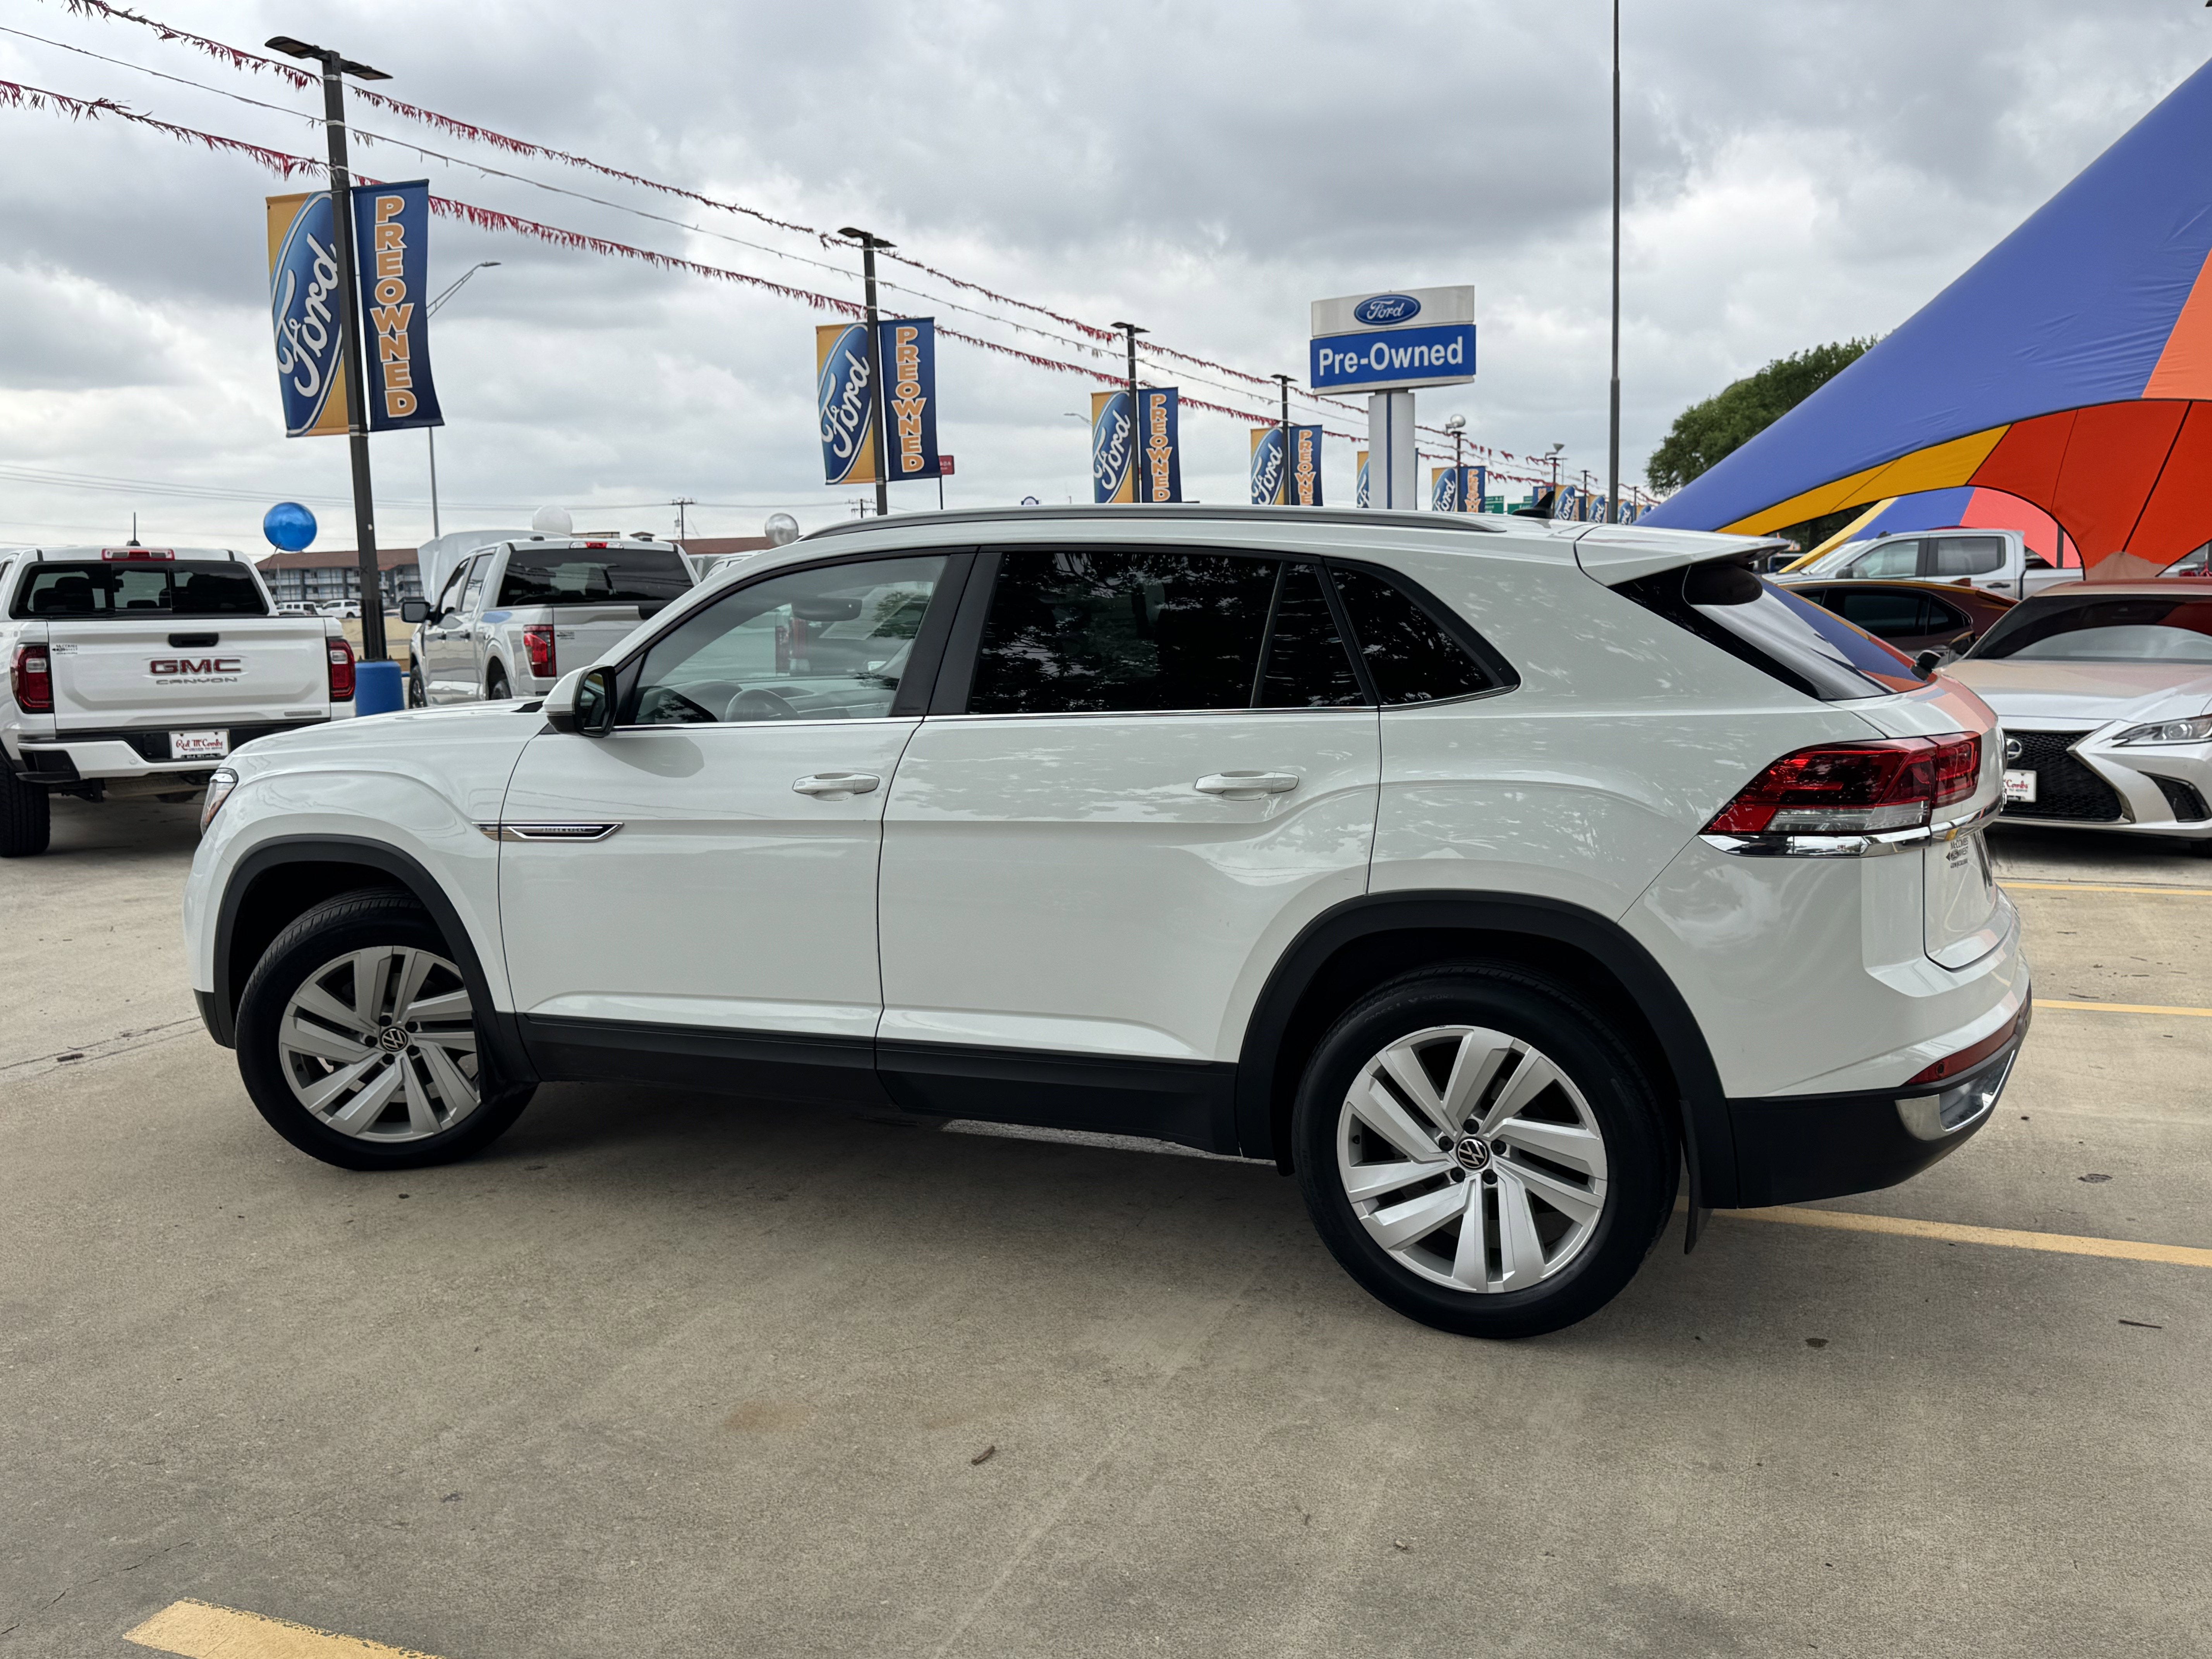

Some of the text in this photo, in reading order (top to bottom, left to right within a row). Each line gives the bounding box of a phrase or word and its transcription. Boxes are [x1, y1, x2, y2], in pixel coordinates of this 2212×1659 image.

[275, 233, 339, 397] Ford
[369, 196, 417, 418] PREOWNED
[1367, 300, 1405, 320] Ford
[1319, 336, 1463, 376] Pre-Owned
[820, 350, 870, 458] Ford
[891, 326, 927, 472] PREOWNED
[1093, 409, 1131, 490] Ford
[1146, 393, 1173, 502] PREOWNED
[1251, 443, 1283, 505] Ford
[1294, 429, 1316, 505] PREOWNE
[149, 659, 242, 675] GMC
[156, 677, 238, 685] CANYON
